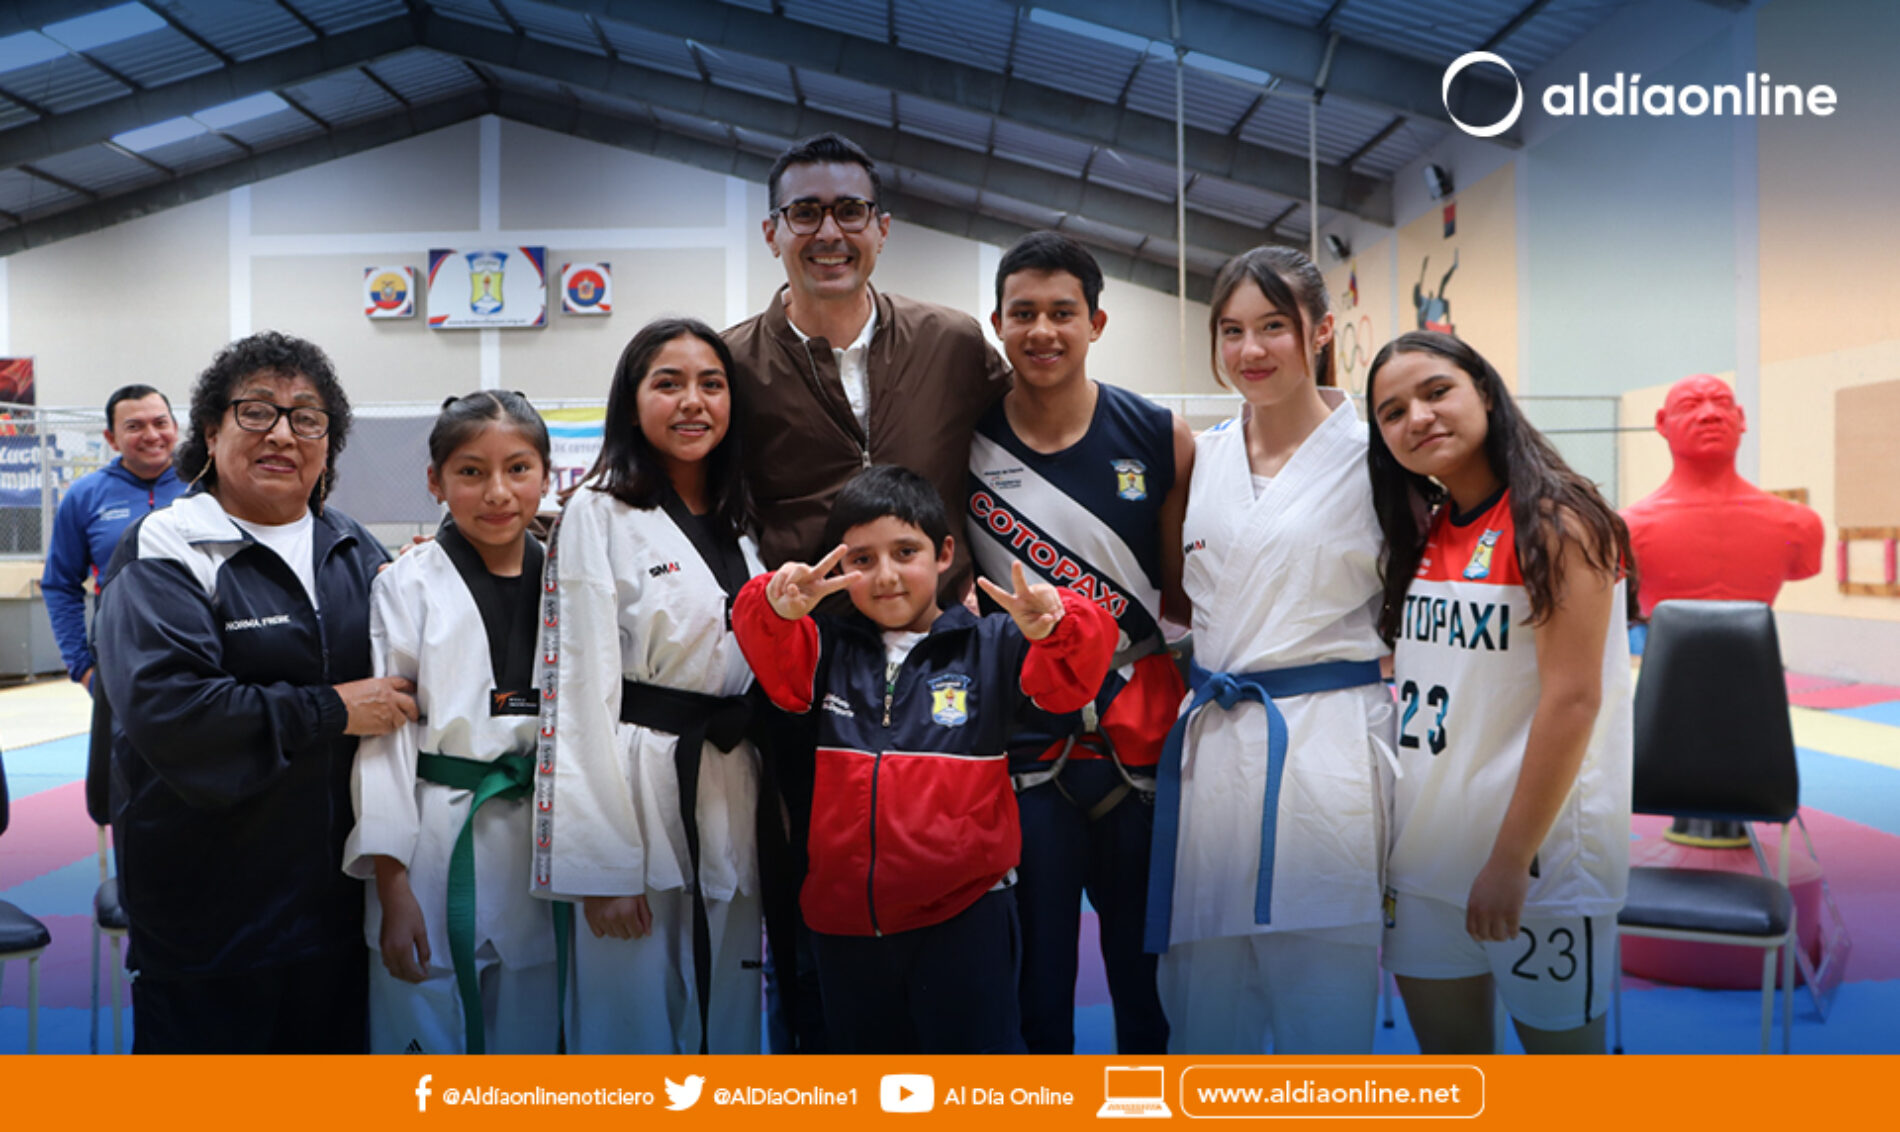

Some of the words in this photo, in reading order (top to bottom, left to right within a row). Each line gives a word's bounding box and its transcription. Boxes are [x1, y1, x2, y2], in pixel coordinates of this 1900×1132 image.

[970, 492, 1129, 617] COTOPAXI
[1397, 595, 1510, 651] TOPAXI
[1399, 680, 1450, 756] 23
[1511, 926, 1577, 982] 23
